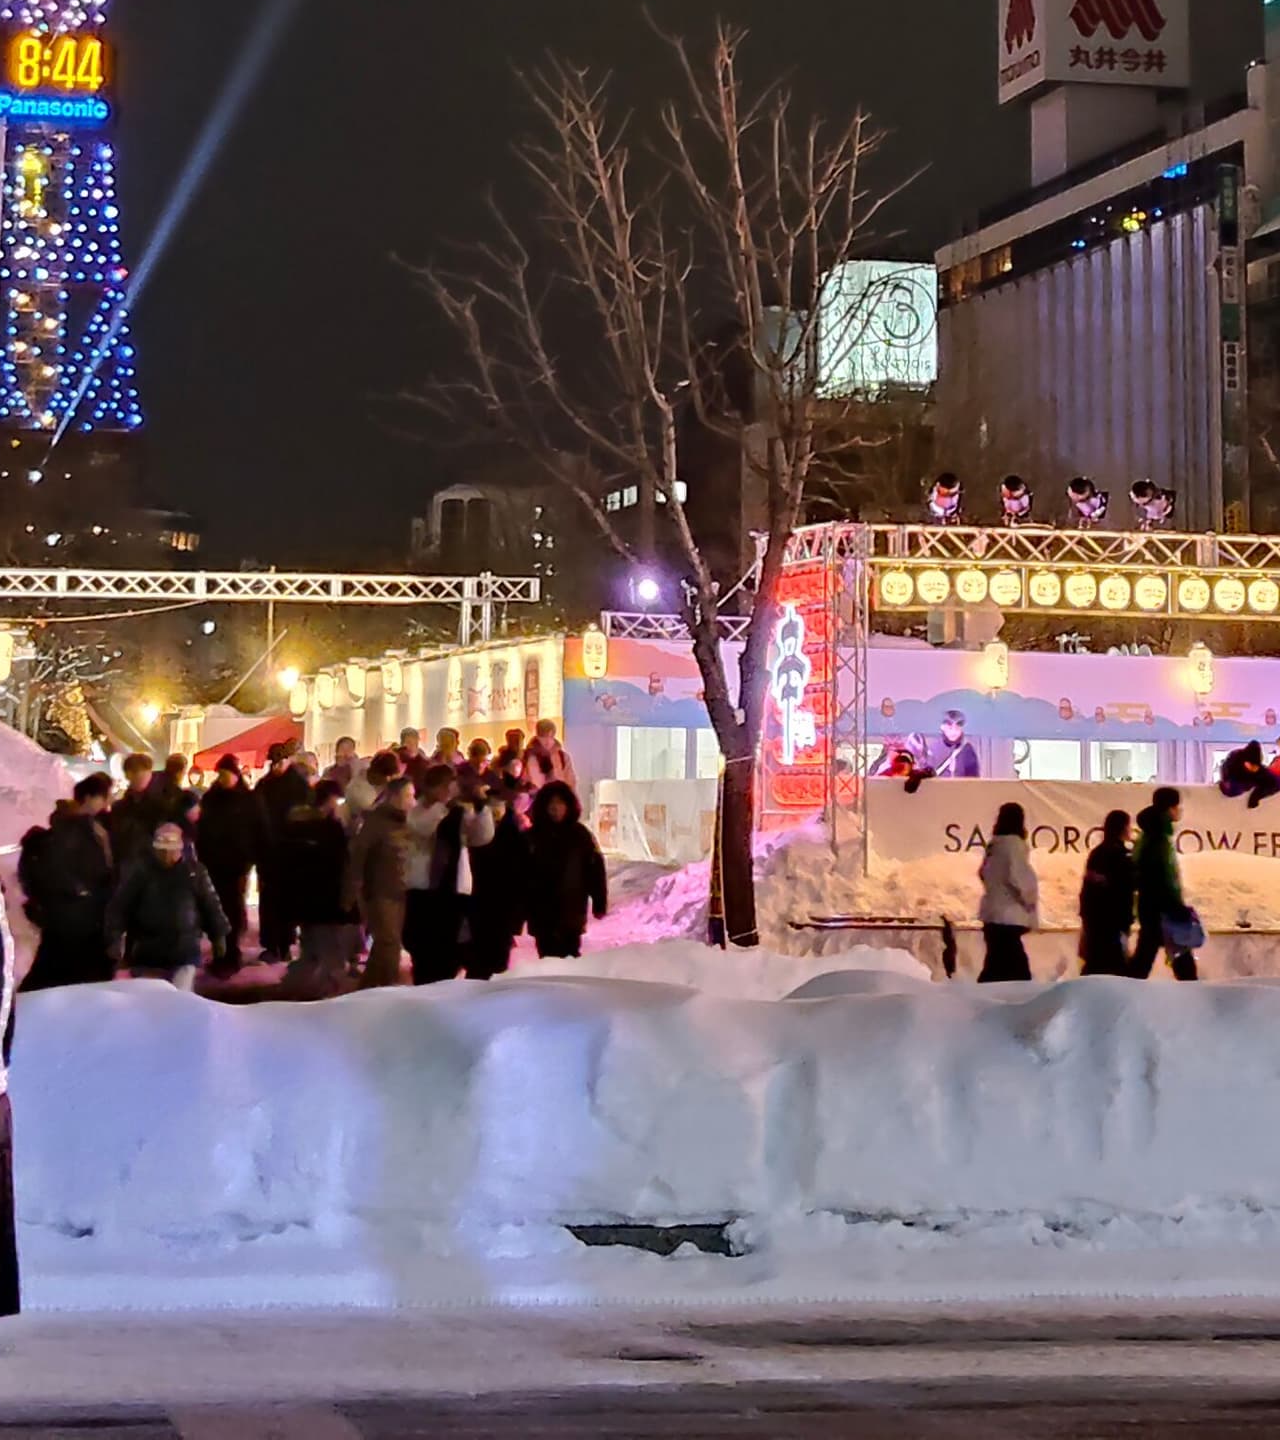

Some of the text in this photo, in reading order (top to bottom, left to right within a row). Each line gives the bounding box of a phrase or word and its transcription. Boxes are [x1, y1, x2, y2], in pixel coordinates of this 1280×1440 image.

[19, 38, 104, 90] 8:44
[1069, 45, 1168, 73] 丸井今井
